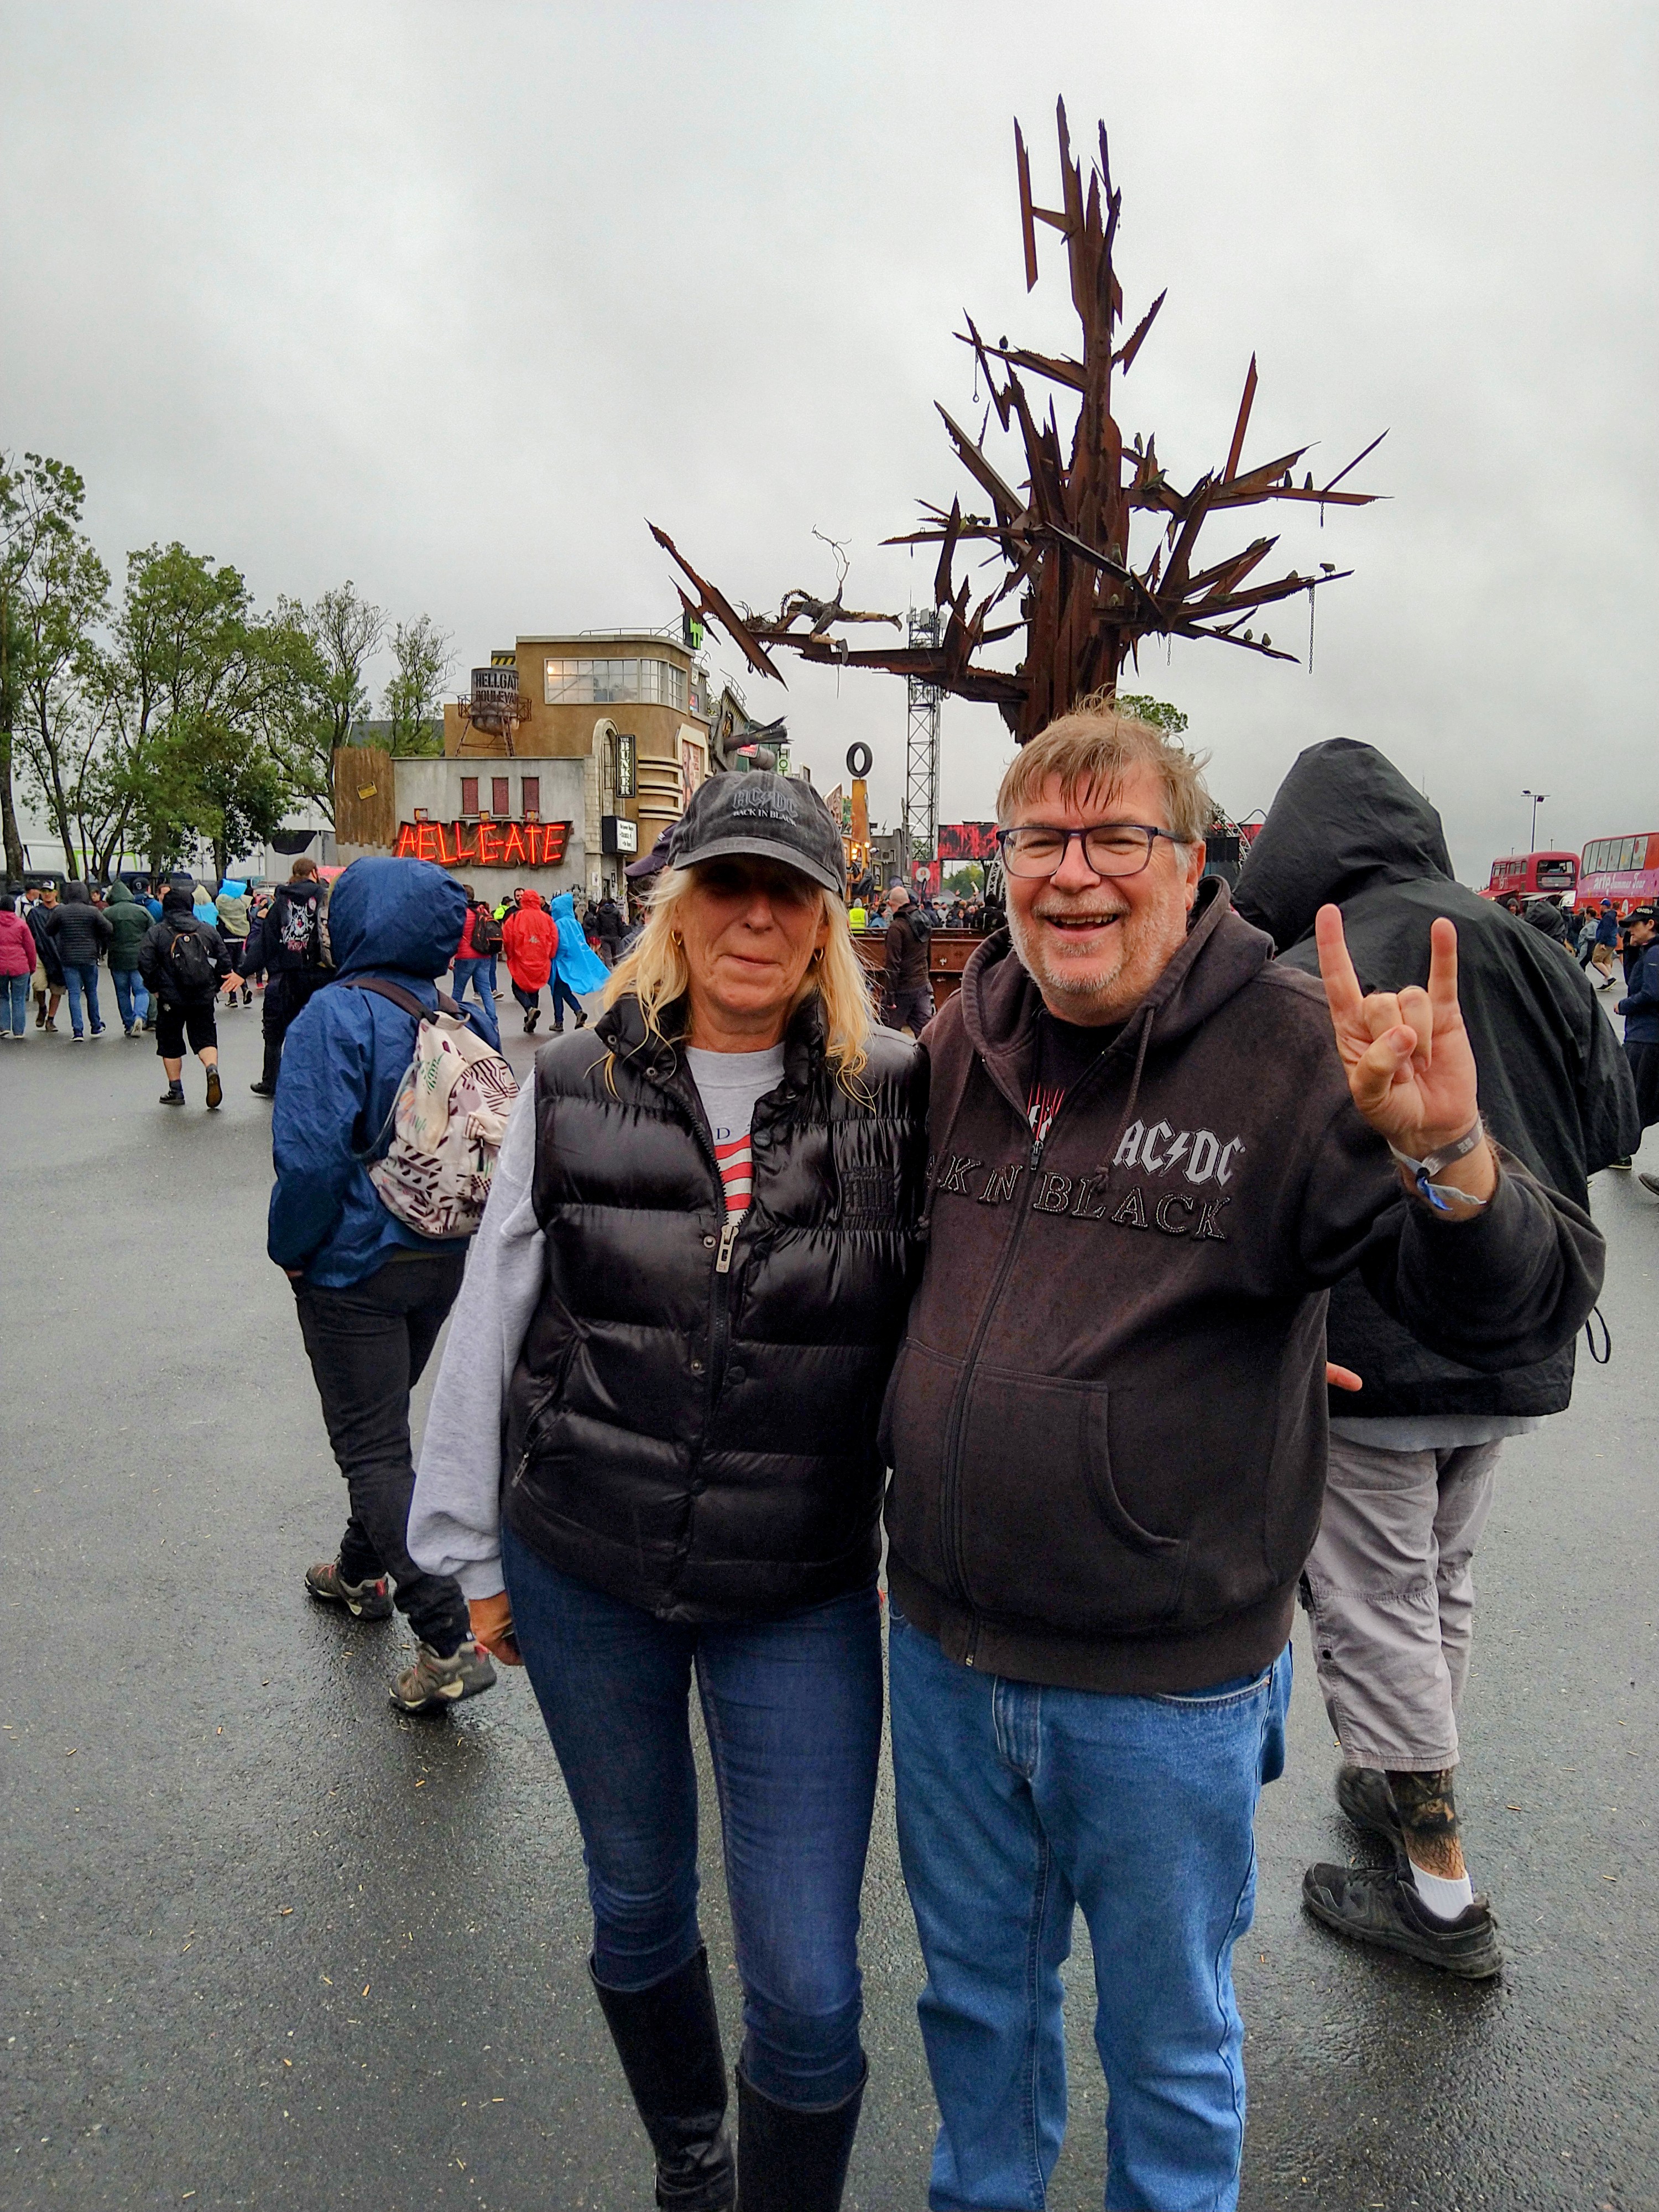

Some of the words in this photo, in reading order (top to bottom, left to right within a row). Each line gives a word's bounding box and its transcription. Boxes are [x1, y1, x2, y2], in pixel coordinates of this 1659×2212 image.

[620, 742, 630, 795] BUNKER
[758, 809, 768, 817] IN
[978, 1164, 1023, 1202] IN
[1033, 1171, 1231, 1240] BLACK
